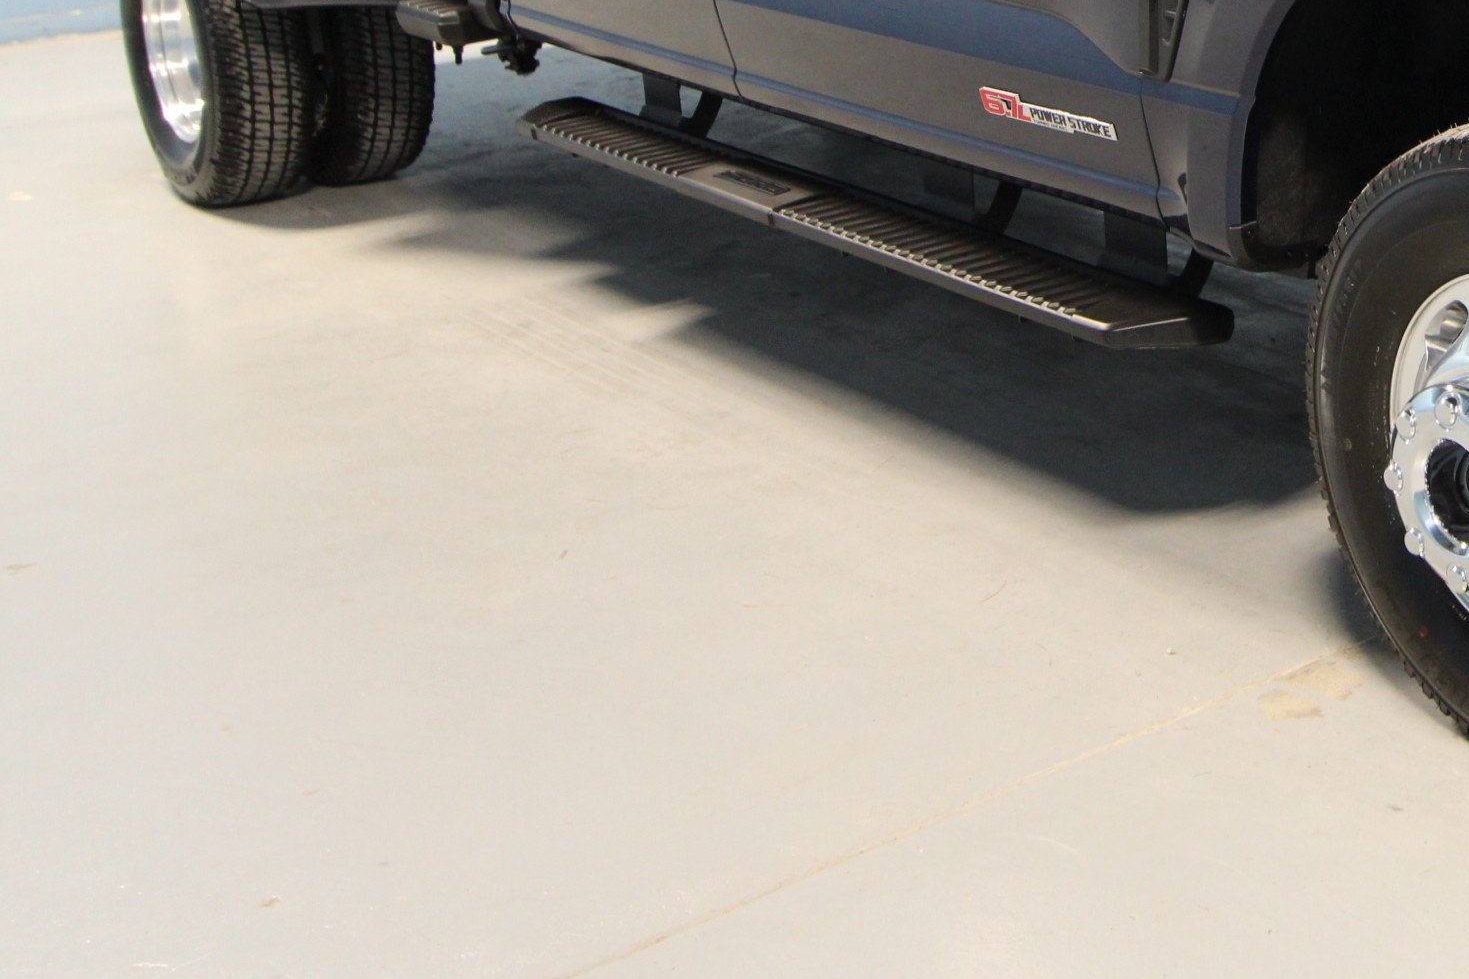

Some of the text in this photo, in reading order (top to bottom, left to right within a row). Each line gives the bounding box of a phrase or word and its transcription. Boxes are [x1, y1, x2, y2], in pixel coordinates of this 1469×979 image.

[979, 86, 1112, 138] 6.7L POWER STROKE
